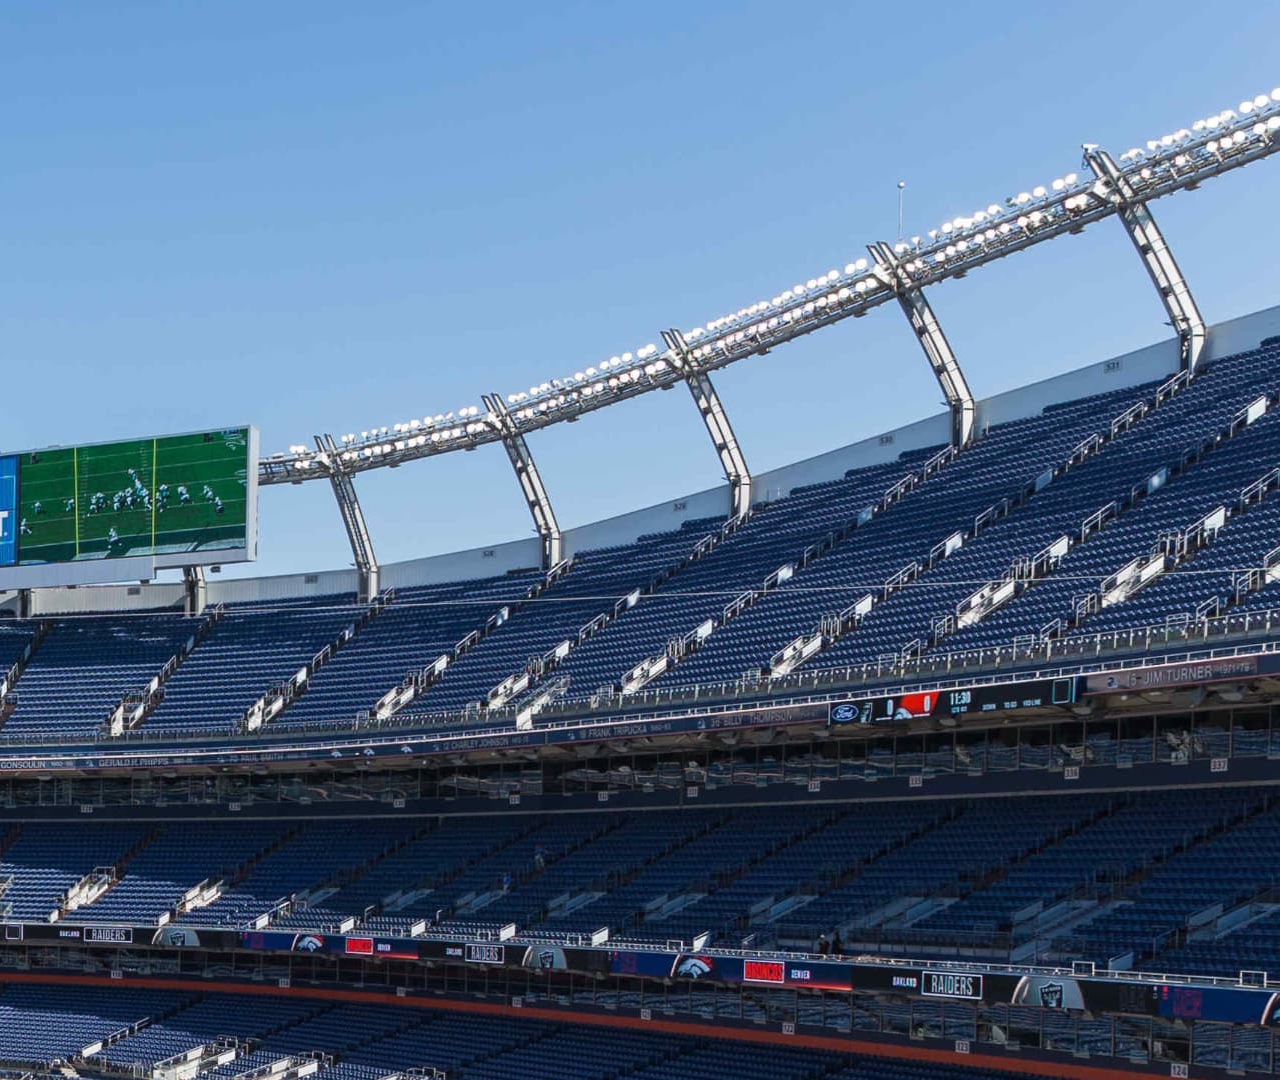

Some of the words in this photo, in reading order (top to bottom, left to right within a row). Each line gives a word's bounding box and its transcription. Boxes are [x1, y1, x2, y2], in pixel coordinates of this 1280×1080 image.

[1144, 671, 1162, 684] JIM
[1167, 665, 1213, 681] TURNER
[924, 695, 931, 712] 0
[950, 691, 971, 706] 11:30
[887, 699, 894, 715] 0
[749, 710, 792, 724] THOMPSON
[588, 727, 611, 737] FRANK
[613, 724, 647, 735] TRIPUCKA
[0, 761, 46, 769] GONSOULIN
[98, 759, 129, 767] GERALD
[139, 758, 169, 766] PHIPPS
[92, 929, 125, 940] RAIDERS
[471, 946, 499, 961] RAIDERS
[745, 961, 783, 981] BRONCOS
[932, 974, 973, 995] RAIDERS
[1172, 1064, 1187, 1078] 124
